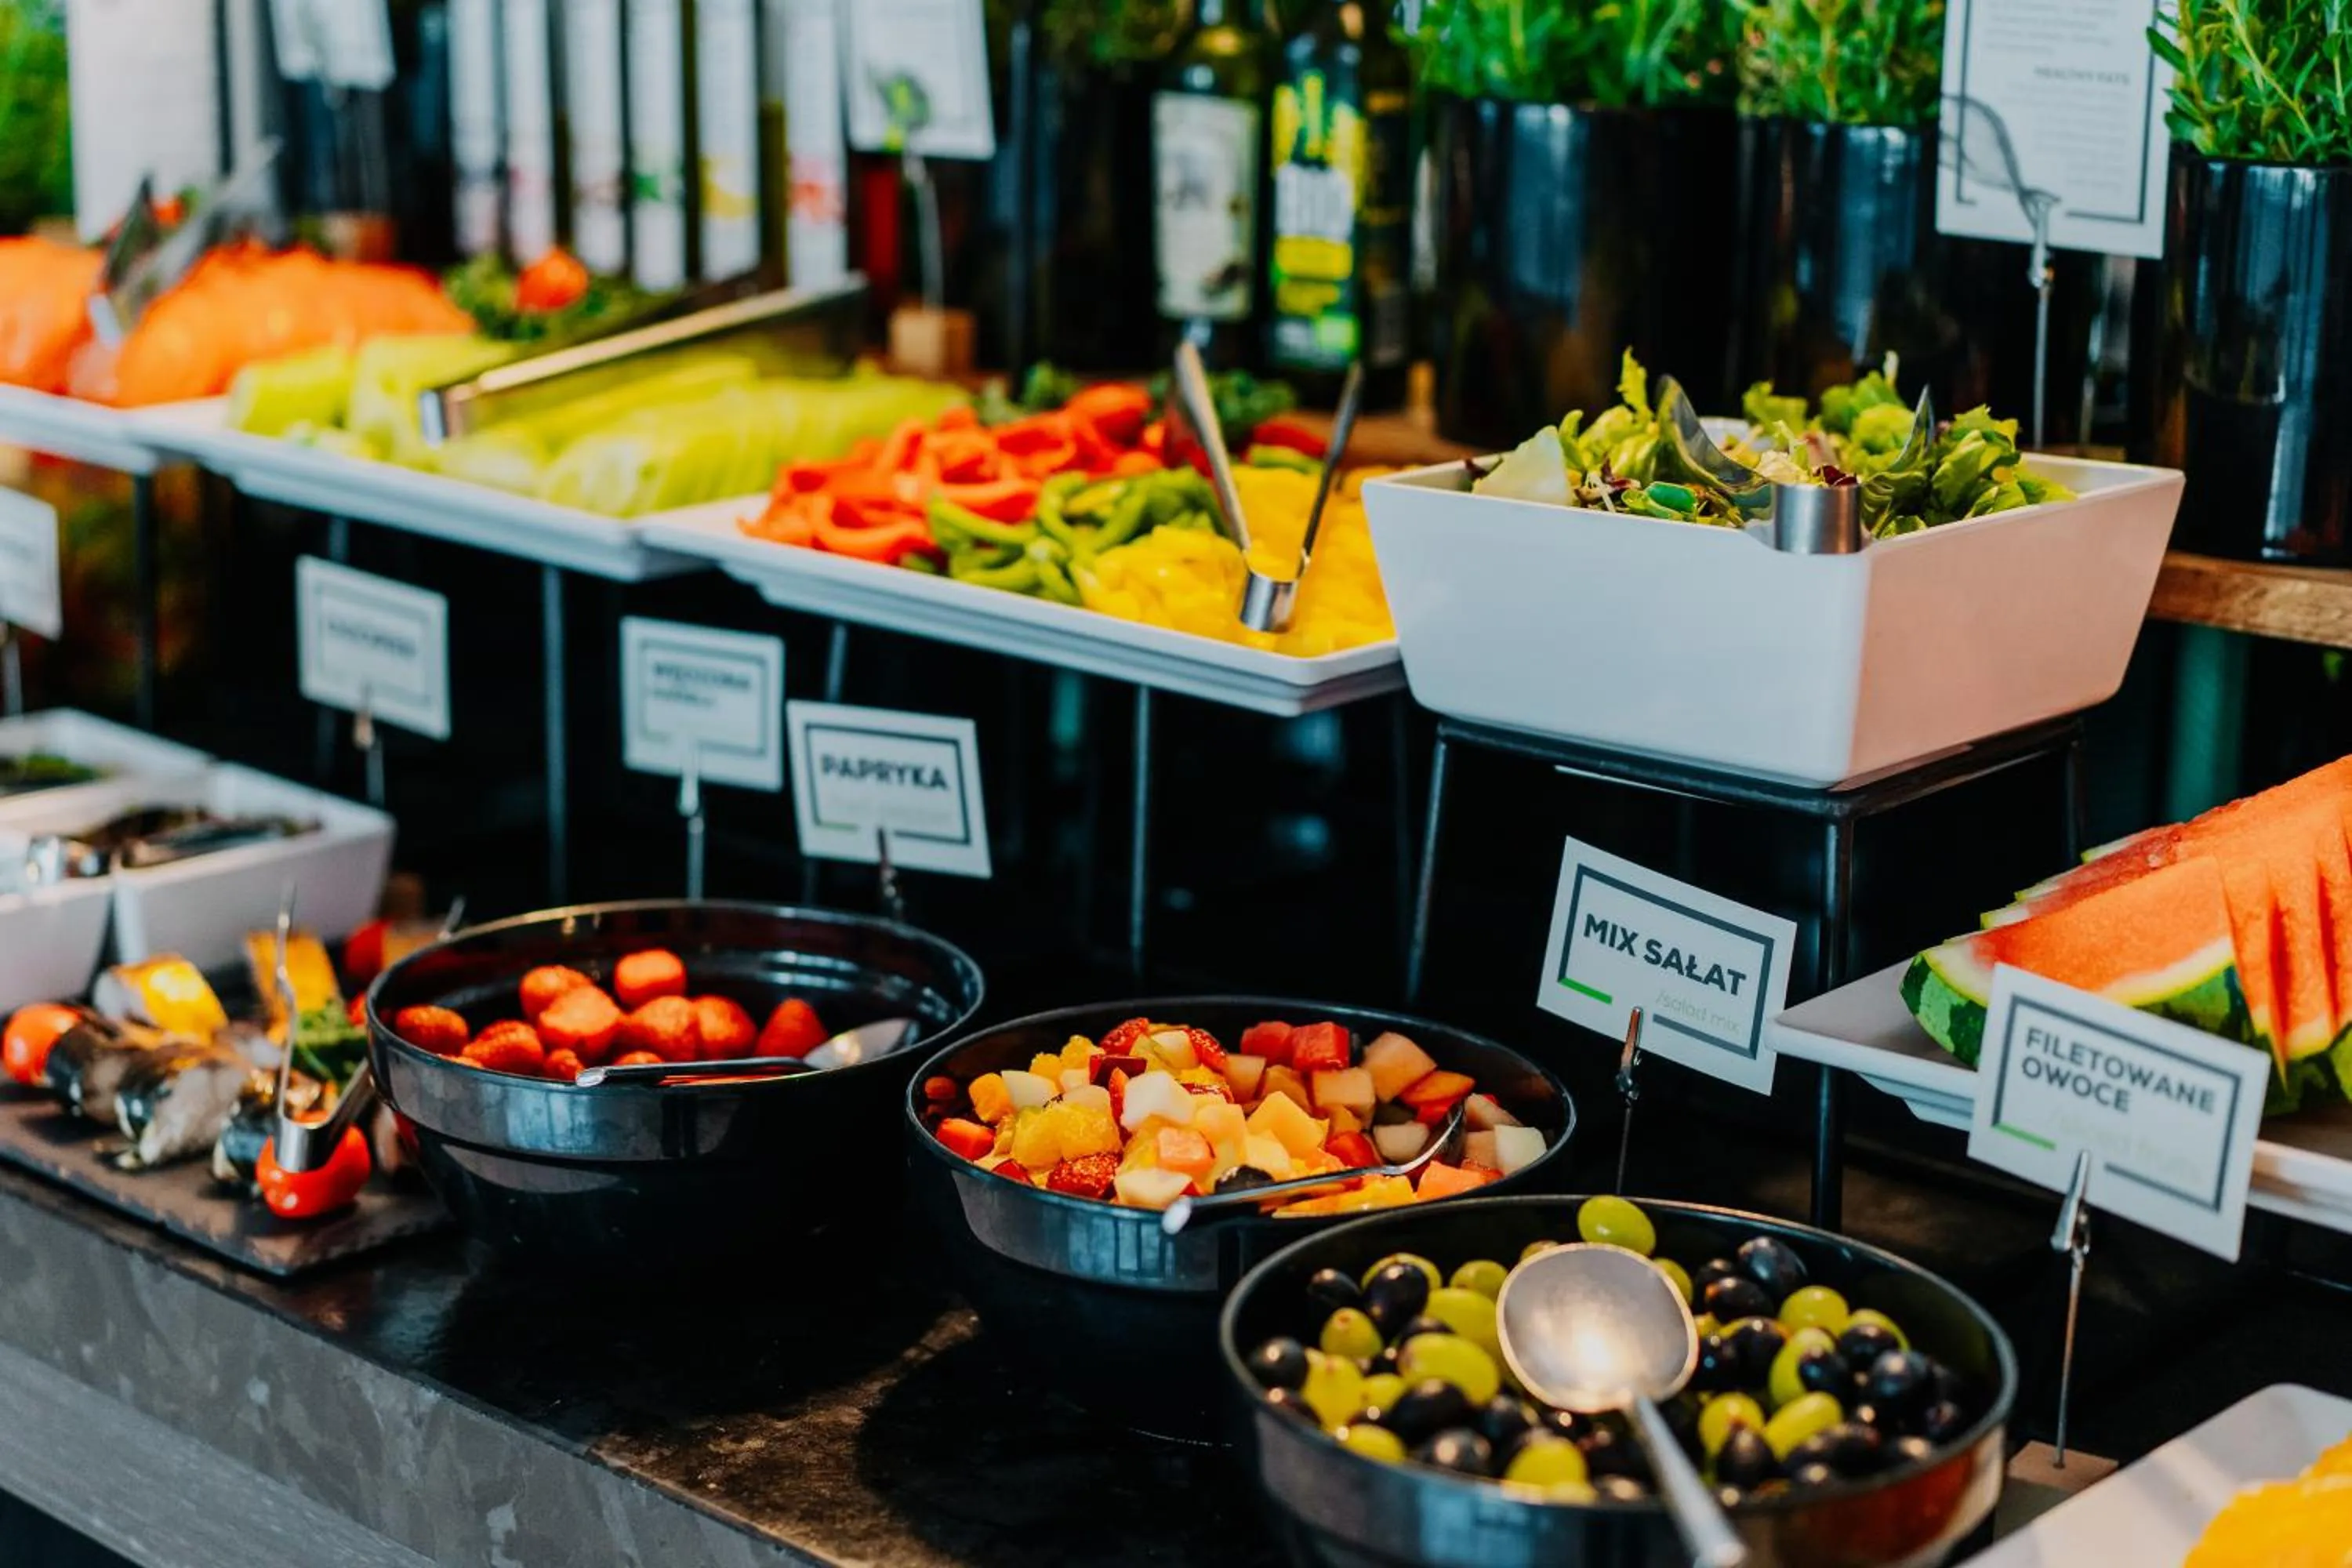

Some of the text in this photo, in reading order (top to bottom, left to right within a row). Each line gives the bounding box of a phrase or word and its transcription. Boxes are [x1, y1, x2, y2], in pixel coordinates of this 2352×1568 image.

[821, 754, 948, 790] PAPRYKA
[1584, 913, 1747, 996] MIX SAŁAT
[2021, 1056, 2132, 1112] OWOCE
[2025, 1027, 2217, 1114] FILETOWANE
